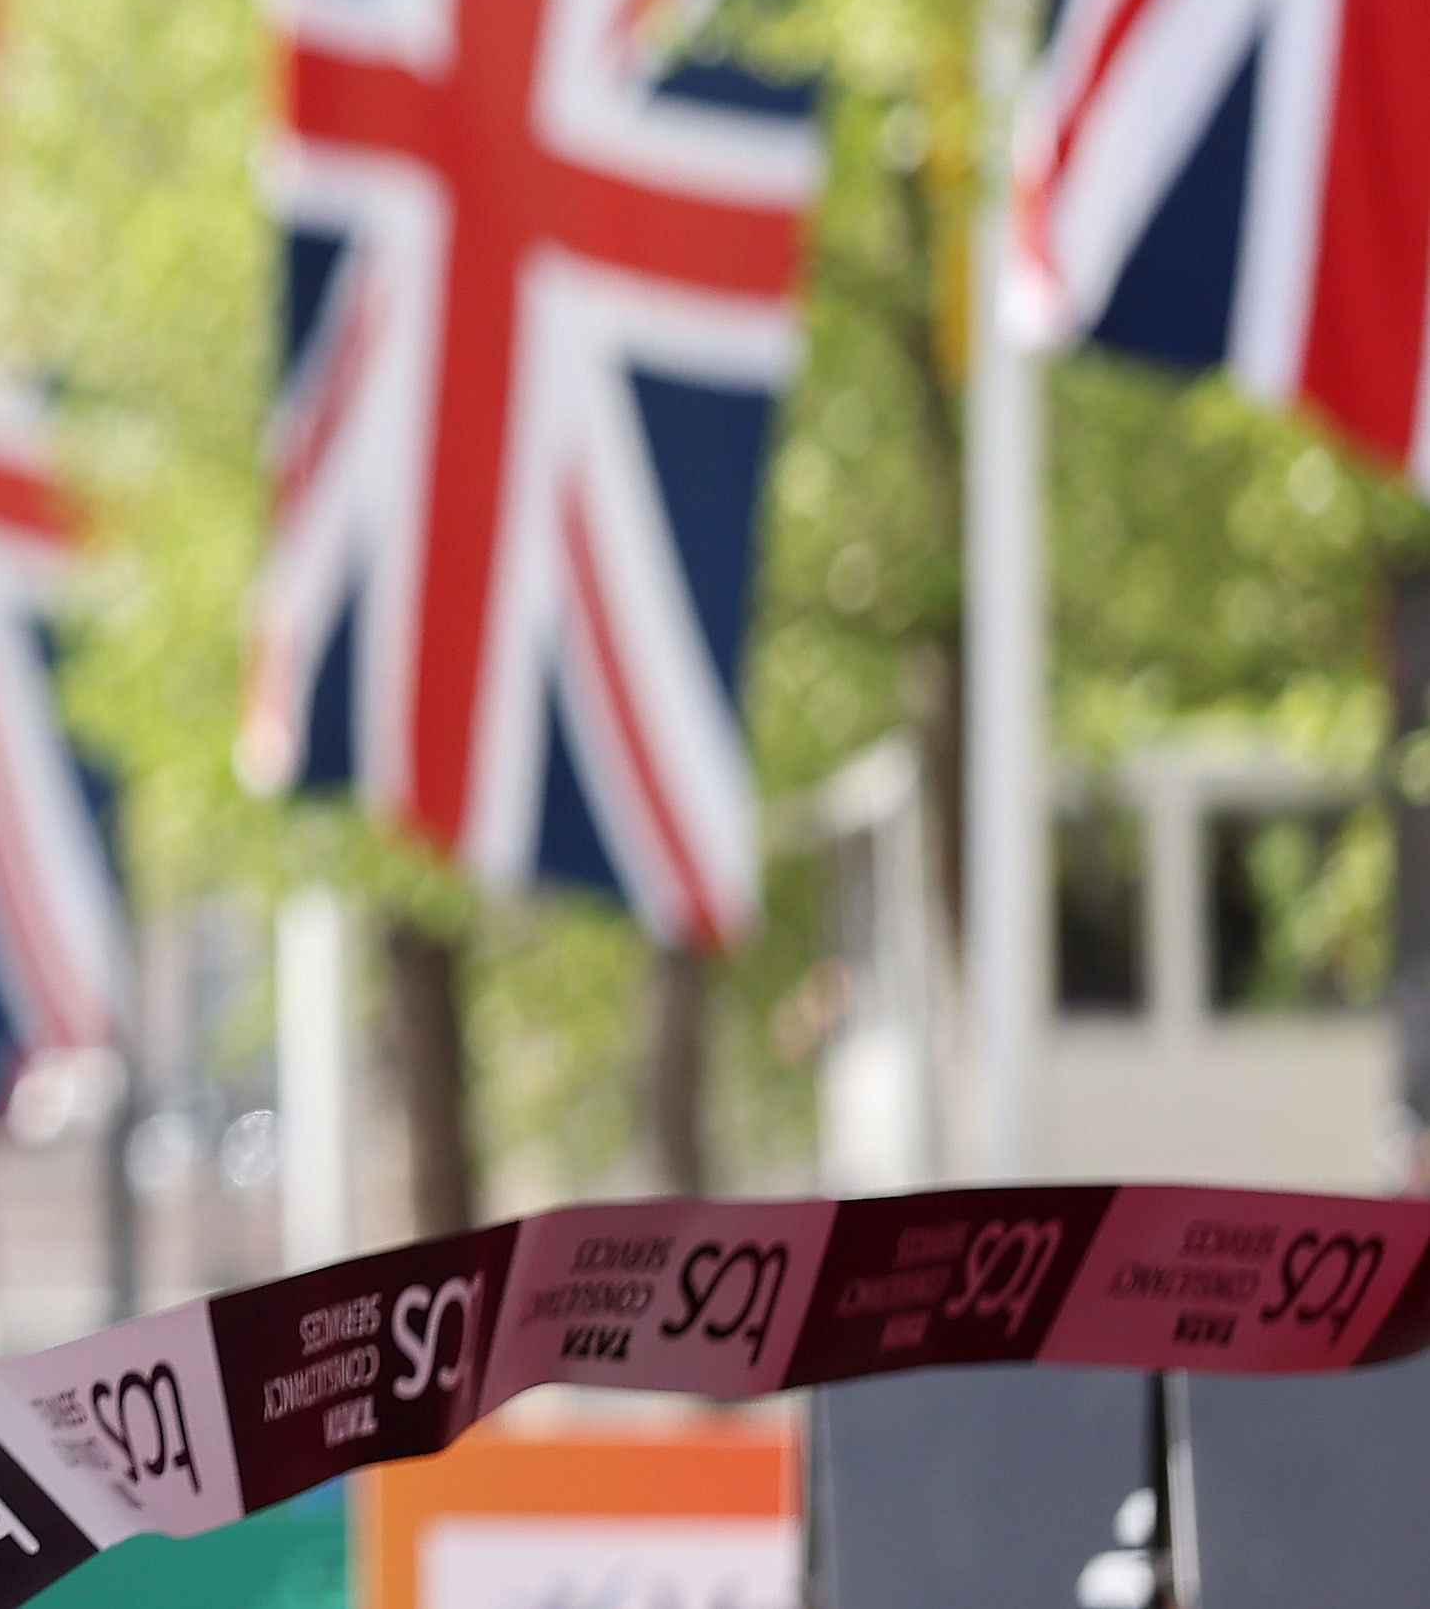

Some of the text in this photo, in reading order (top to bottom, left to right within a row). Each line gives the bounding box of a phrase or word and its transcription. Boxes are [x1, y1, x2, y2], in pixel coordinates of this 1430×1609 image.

[560, 1326, 631, 1364] TATA
[662, 1238, 791, 1369] tcs
[1261, 1229, 1384, 1348] tcs
